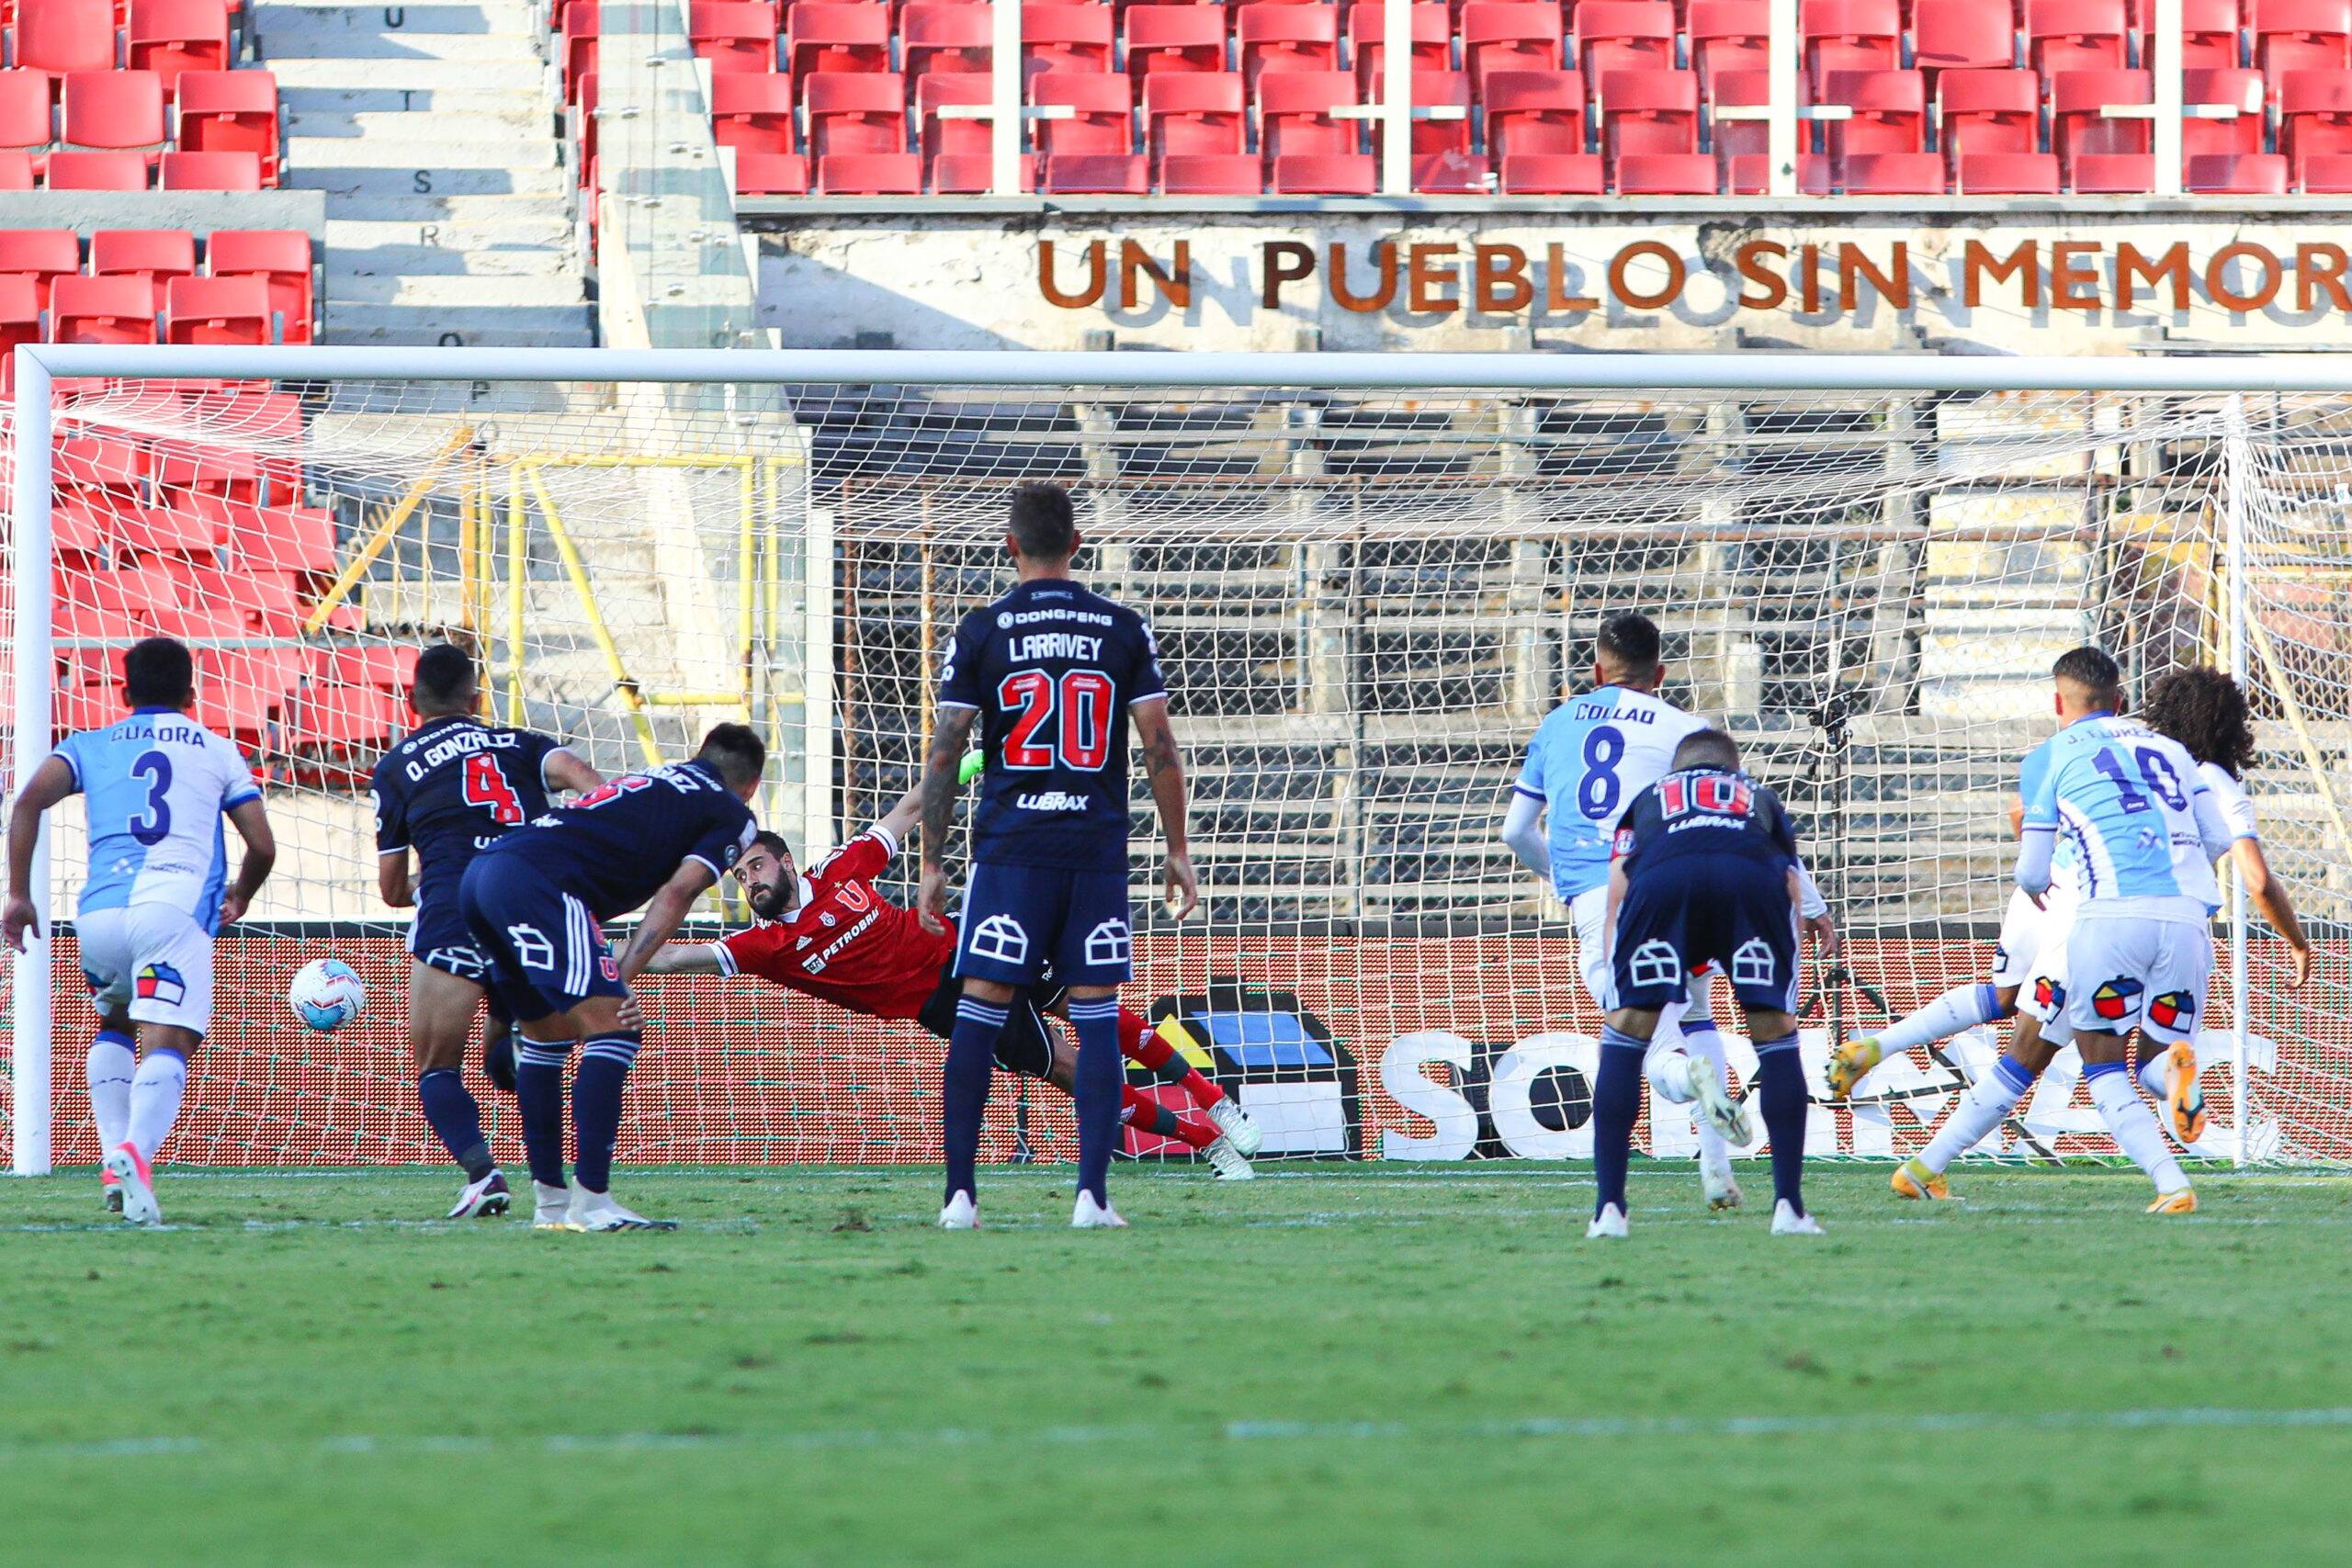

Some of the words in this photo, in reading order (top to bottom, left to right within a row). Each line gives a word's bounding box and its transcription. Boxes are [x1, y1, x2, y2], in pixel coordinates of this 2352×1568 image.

[384, 7, 404, 28] U
[399, 90, 416, 111] T
[413, 170, 432, 194] S
[420, 224, 440, 248] R
[1038, 239, 1191, 310] UN
[1262, 240, 1686, 313] PUEBLO
[1736, 240, 1910, 313] SIN
[1963, 239, 2352, 311] MEMOR
[1015, 608, 1113, 627] DONGFENG
[1009, 633, 1102, 662] LARRIVEY
[997, 668, 1115, 773] 20
[1574, 704, 1657, 725] COLLAO
[111, 726, 206, 749] CUADRA
[405, 761, 430, 782] O.
[1577, 725, 1625, 820] 8
[2091, 745, 2188, 814] 10
[130, 750, 173, 846] 3
[462, 751, 526, 827] 4
[1016, 791, 1090, 811] LUBRAX
[1654, 773, 1755, 821] 10
[834, 879, 870, 912] U
